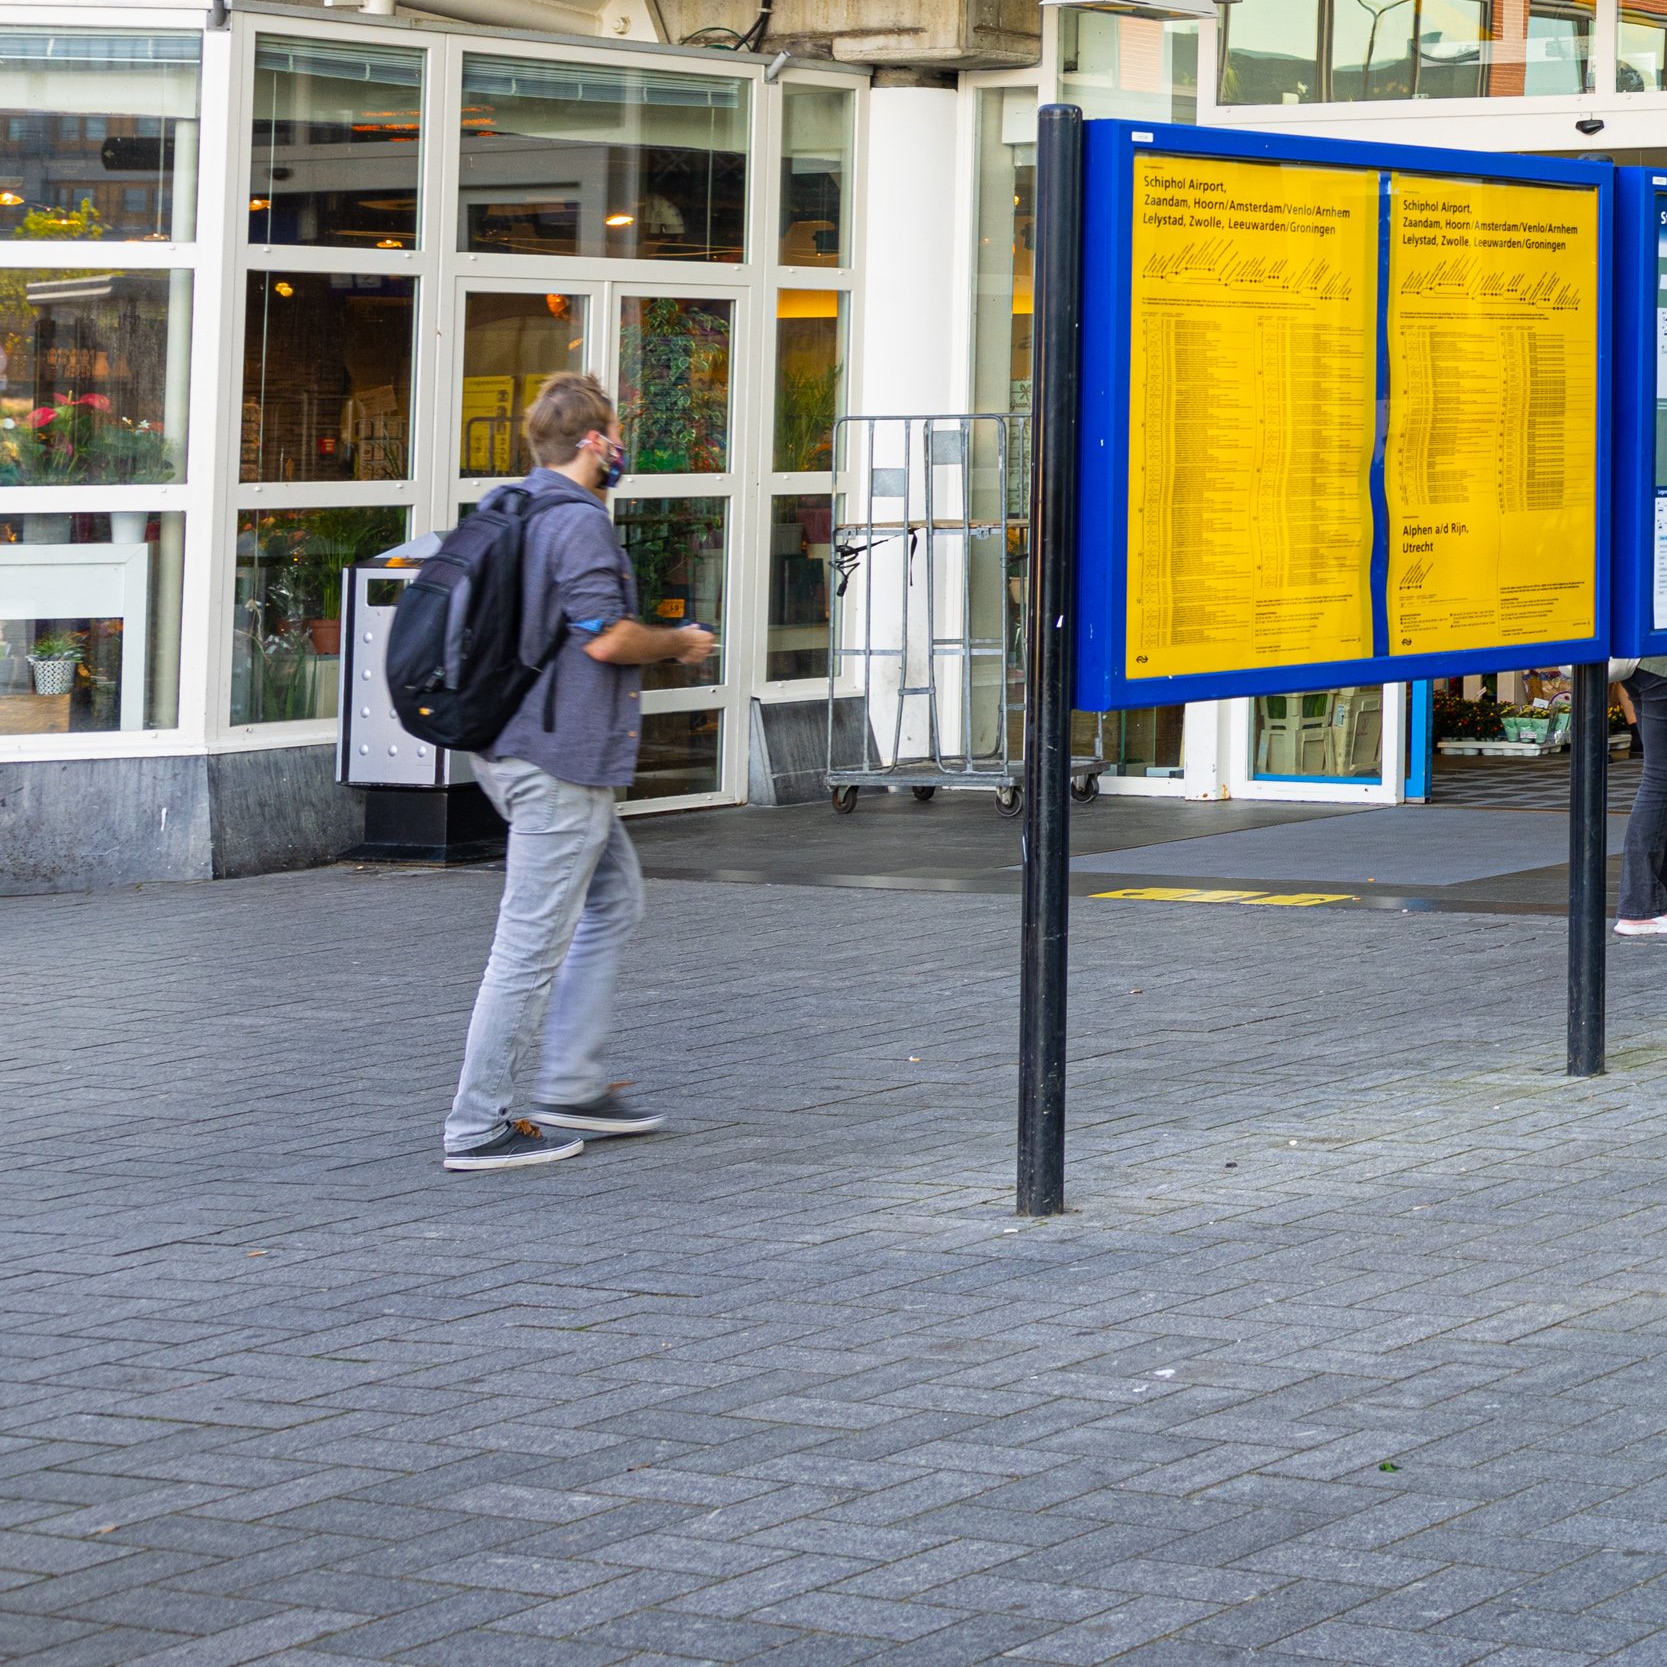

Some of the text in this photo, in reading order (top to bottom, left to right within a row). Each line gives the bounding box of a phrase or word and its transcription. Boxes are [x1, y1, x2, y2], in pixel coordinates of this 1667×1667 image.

[1144, 176, 1227, 193] Schiphol Airport,
[1145, 195, 1351, 218] Zaandam, Hoorn/Amsterdam/Venlo/Arnhem
[1403, 200, 1472, 214] Schiphol Airport,
[1143, 213, 1336, 236] Lelystad, Zwolle, Leeuwarden/Groningen
[1403, 217, 1578, 235] Zaandam, Hoorn/Amsterdam/Venlo/Arnhem
[1403, 236, 1566, 252] Lelystad, Zwolle, Leeuwarden/Groningen
[1403, 522, 1469, 538] Alphen a/d Rijn,
[1402, 542, 1434, 553] Utrecht
